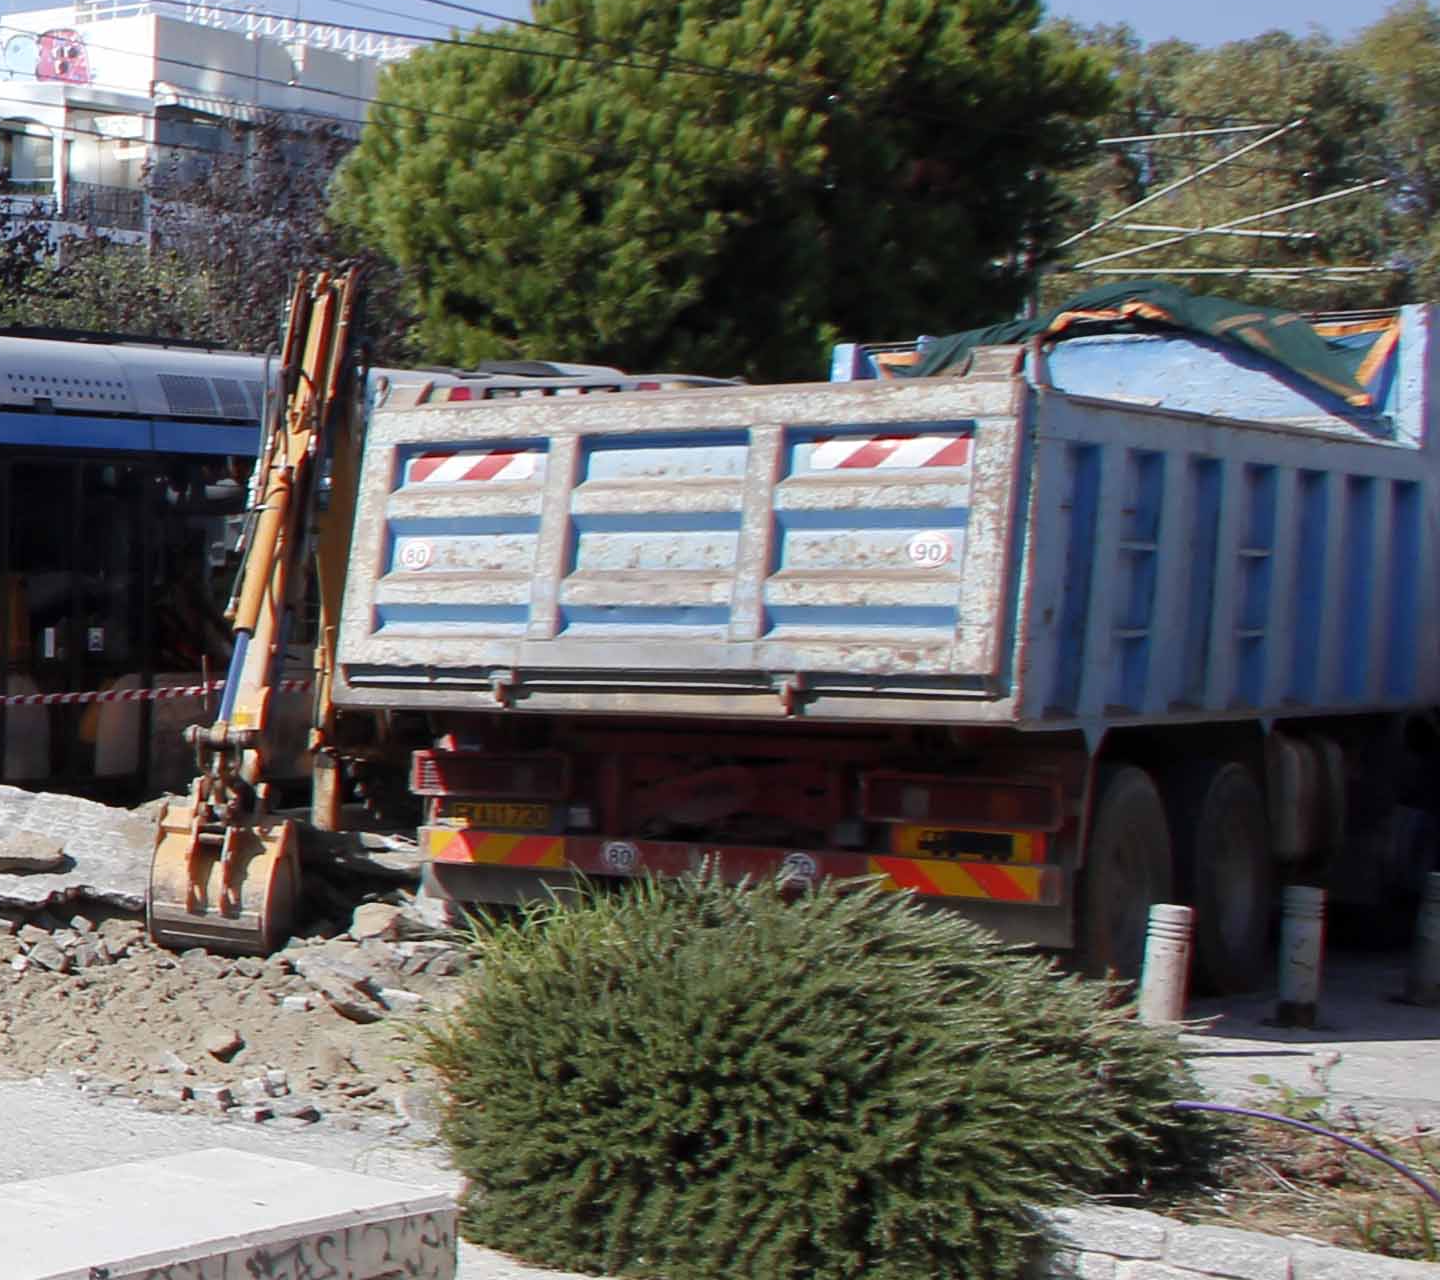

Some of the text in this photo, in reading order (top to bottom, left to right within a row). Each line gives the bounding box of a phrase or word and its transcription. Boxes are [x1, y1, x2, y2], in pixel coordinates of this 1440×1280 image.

[404, 545, 427, 565] 80
[915, 541, 942, 562] 90
[608, 849, 632, 865] 80
